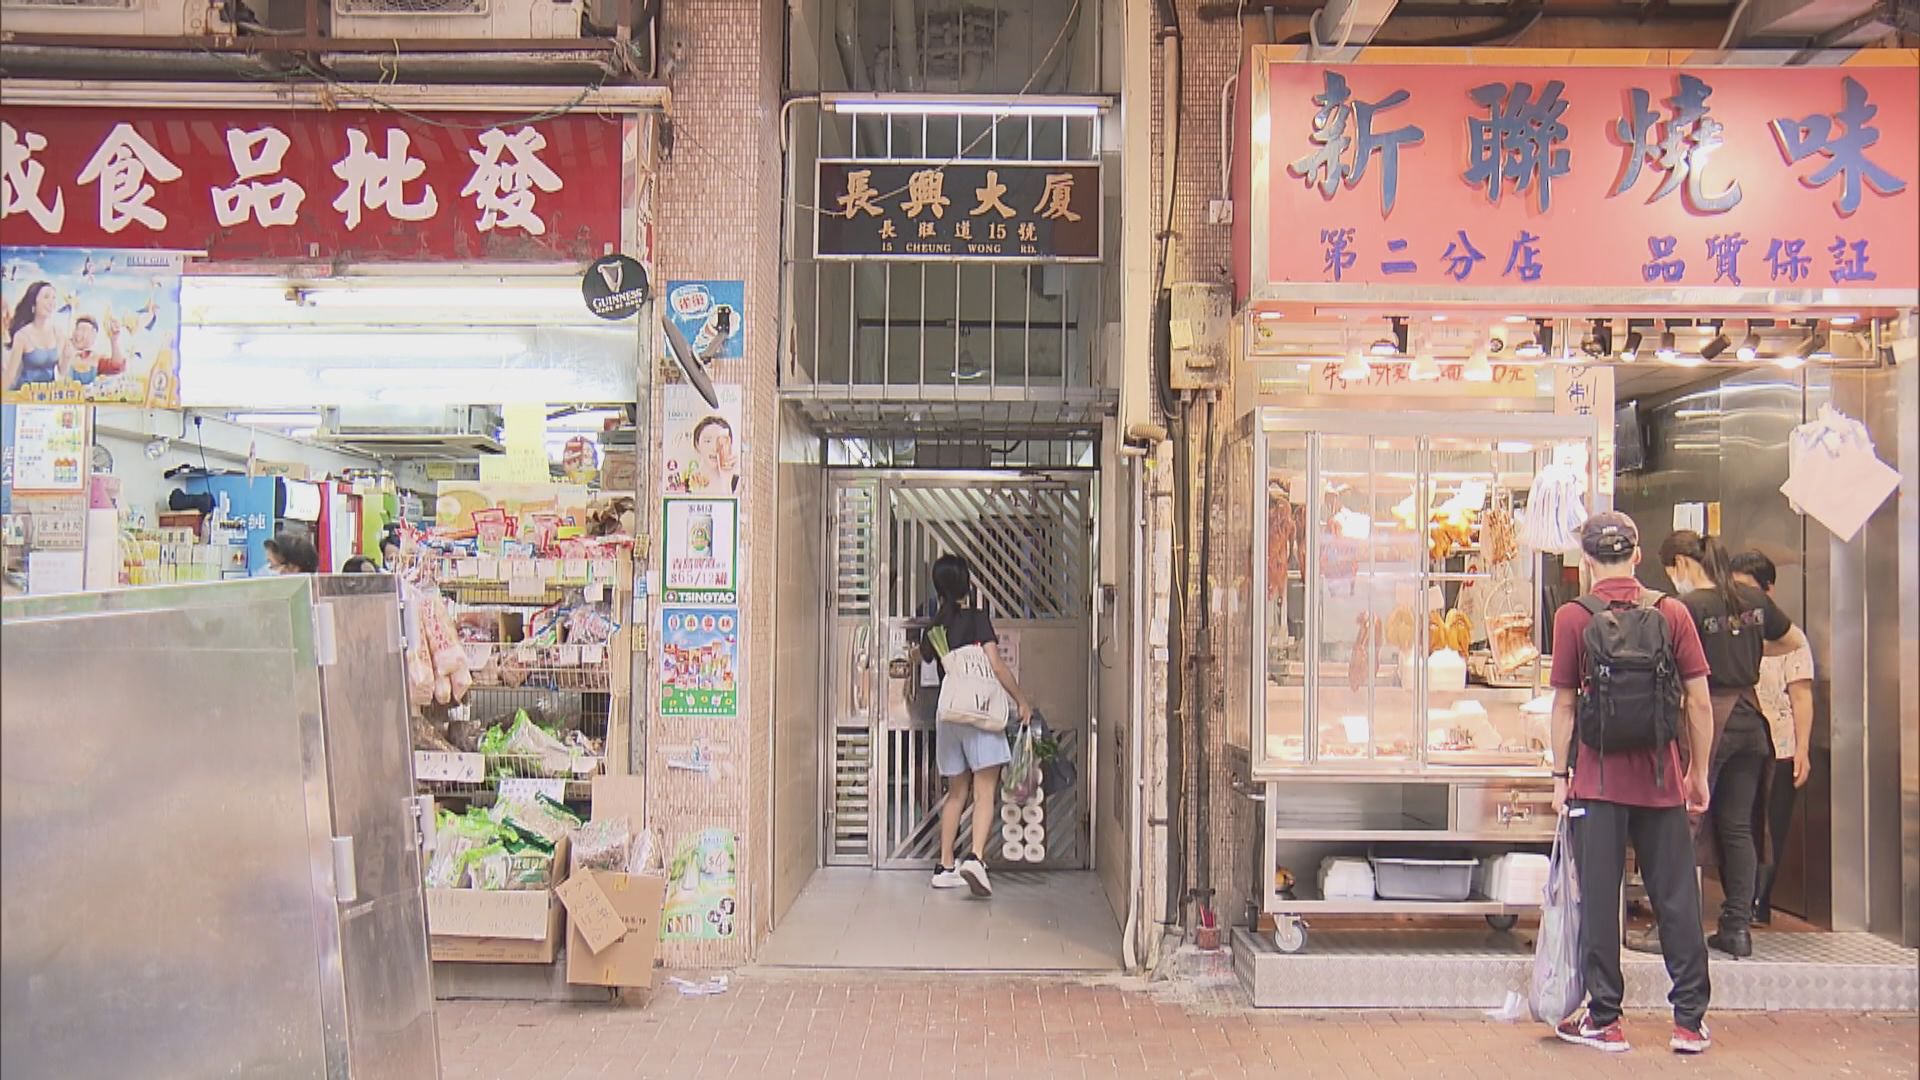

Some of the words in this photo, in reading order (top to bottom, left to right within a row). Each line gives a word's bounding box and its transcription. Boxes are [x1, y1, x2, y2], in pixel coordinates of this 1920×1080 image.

[1288, 70, 1907, 219] 新聯燒味
[881, 242, 893, 252] 15
[906, 242, 951, 253] CHEUNG
[967, 243, 1001, 253] WONG
[1320, 229, 1544, 282] 第二分店
[592, 288, 643, 309] GUINNESS
[678, 591, 735, 603] TSINGTAO
